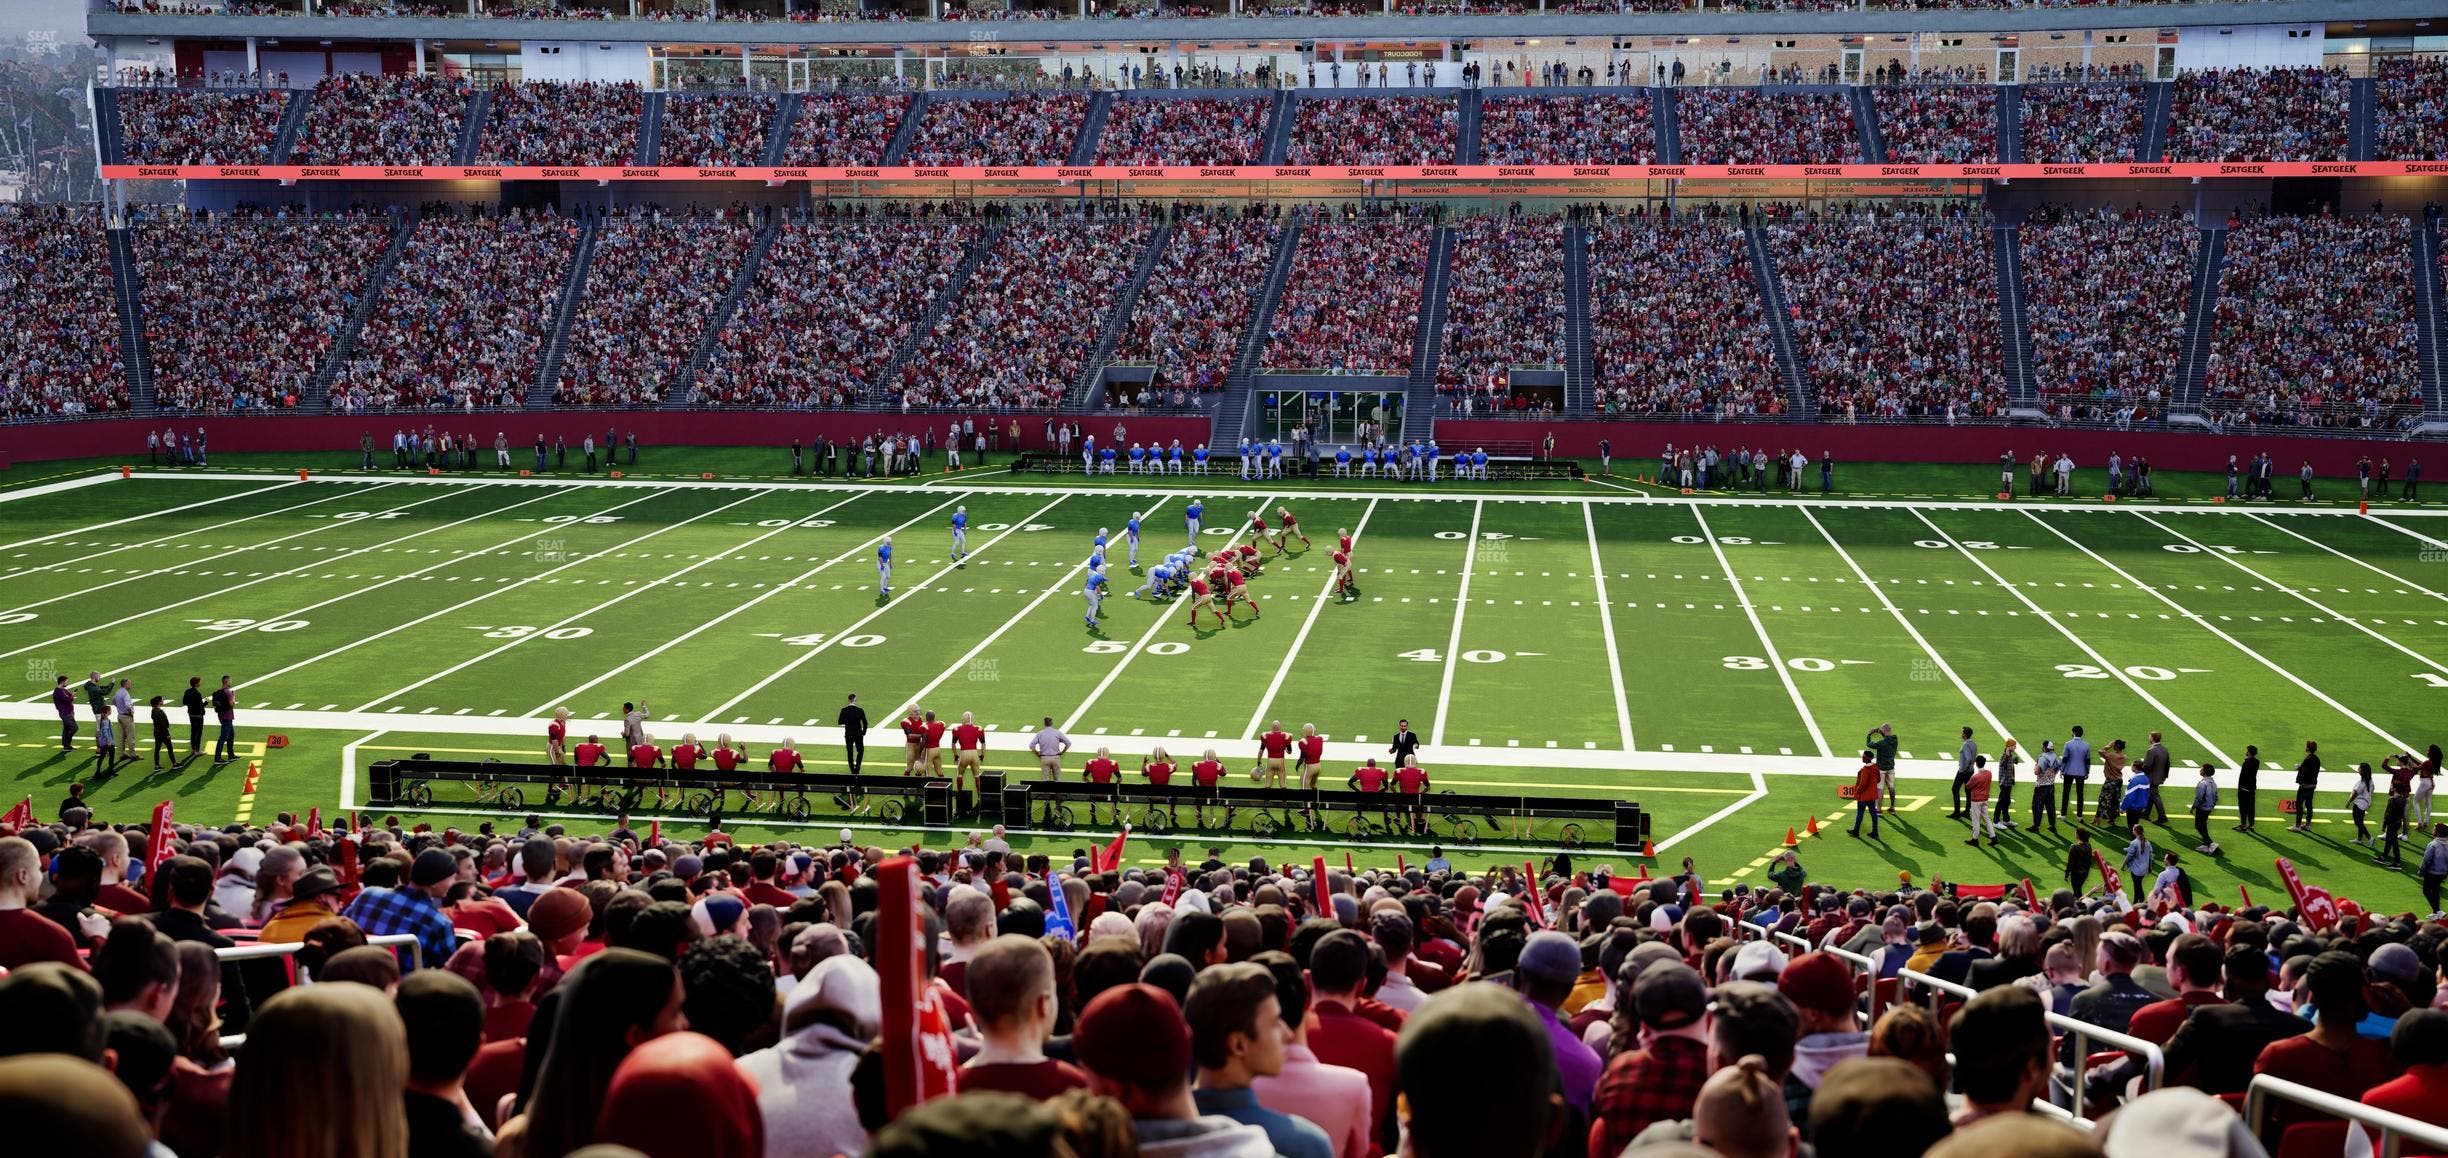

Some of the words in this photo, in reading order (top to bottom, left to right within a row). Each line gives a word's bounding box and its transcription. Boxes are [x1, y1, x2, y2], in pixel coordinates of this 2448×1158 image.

[138, 168, 179, 177] SEATGEEK
[220, 168, 260, 177] SEATGEEK
[301, 168, 341, 177] SEATGEEK
[384, 168, 423, 177] SEATGEEK
[463, 168, 502, 177] SEATGEEK
[541, 169, 580, 177] SEATGEEK
[622, 169, 660, 177] SEATGEEK
[699, 169, 737, 178] SEATGEEK
[773, 169, 808, 178] SEATGEEK
[845, 169, 879, 178] SEATGEEK
[913, 169, 949, 178] SEATGEEK
[984, 169, 1019, 177] SEATGEEK
[1057, 168, 1092, 177] SEATGEEK
[1128, 168, 1164, 177] SEATGEEK
[1200, 168, 1237, 177] SEATGEEK
[1275, 168, 1311, 177] SEATGEEK
[1348, 168, 1384, 177] SEATGEEK
[1421, 168, 1458, 177] SEATGEEK
[1498, 168, 1535, 177] SEATGEEK
[1573, 167, 1610, 176] SEATGEEK
[1648, 167, 1686, 176] SEATGEEK
[1727, 167, 1765, 176] SEATGEEK
[1804, 167, 1842, 176] SEATGEEK
[1881, 167, 1920, 176] SEATGEEK
[1962, 166, 2001, 176] SEATGEEK
[2043, 166, 2085, 176] SEATGEEK
[2128, 165, 2172, 175] SEATGEEK
[2220, 165, 2265, 174] SEATGEEK
[2311, 164, 2357, 174] SEATGEEK
[0, 613, 39, 625] 0
[194, 618, 311, 632] 20
[483, 625, 594, 640] 30
[780, 633, 887, 647] 40
[1081, 640, 1192, 655] 50
[1396, 648, 1507, 663] 40
[1721, 655, 1836, 672] 30
[2053, 664, 2177, 681] 20
[2410, 673, 2448, 688] 1
[271, 736, 282, 745] 30
[1843, 786, 1855, 796] 30
